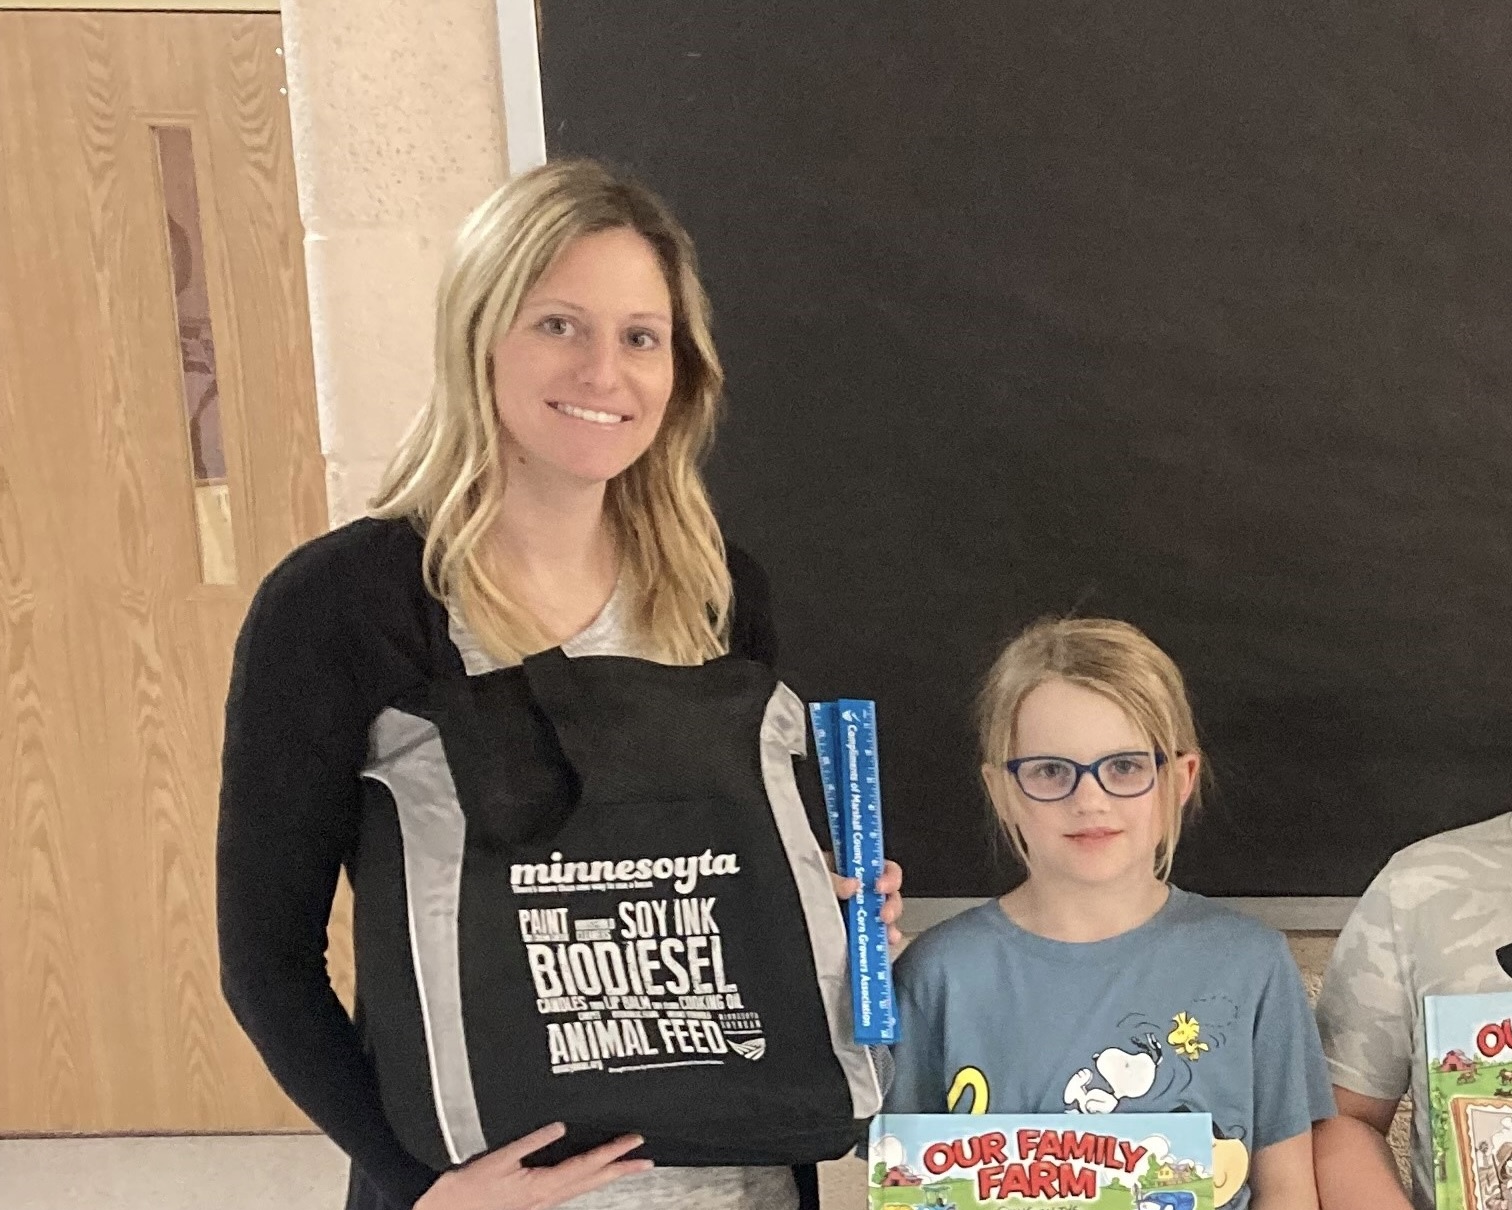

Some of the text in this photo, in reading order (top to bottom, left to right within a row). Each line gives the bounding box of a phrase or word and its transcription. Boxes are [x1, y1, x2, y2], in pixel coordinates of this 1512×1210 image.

[845, 724, 859, 782] Compliments
[850, 782, 861, 794] of
[851, 794, 862, 831] Marshall
[510, 848, 741, 894] minnesoyta
[852, 832, 864, 869] County
[518, 907, 569, 935] PAINT
[618, 899, 668, 940] SOY
[674, 897, 720, 936] INK
[525, 936, 738, 999] BIODIESEL
[858, 934, 870, 972] Growers
[860, 974, 873, 1027] Association
[546, 1017, 729, 1065] ANIMAL FEED
[922, 1129, 1149, 1176] OUR FAMILY
[977, 1161, 1098, 1201] FARM
